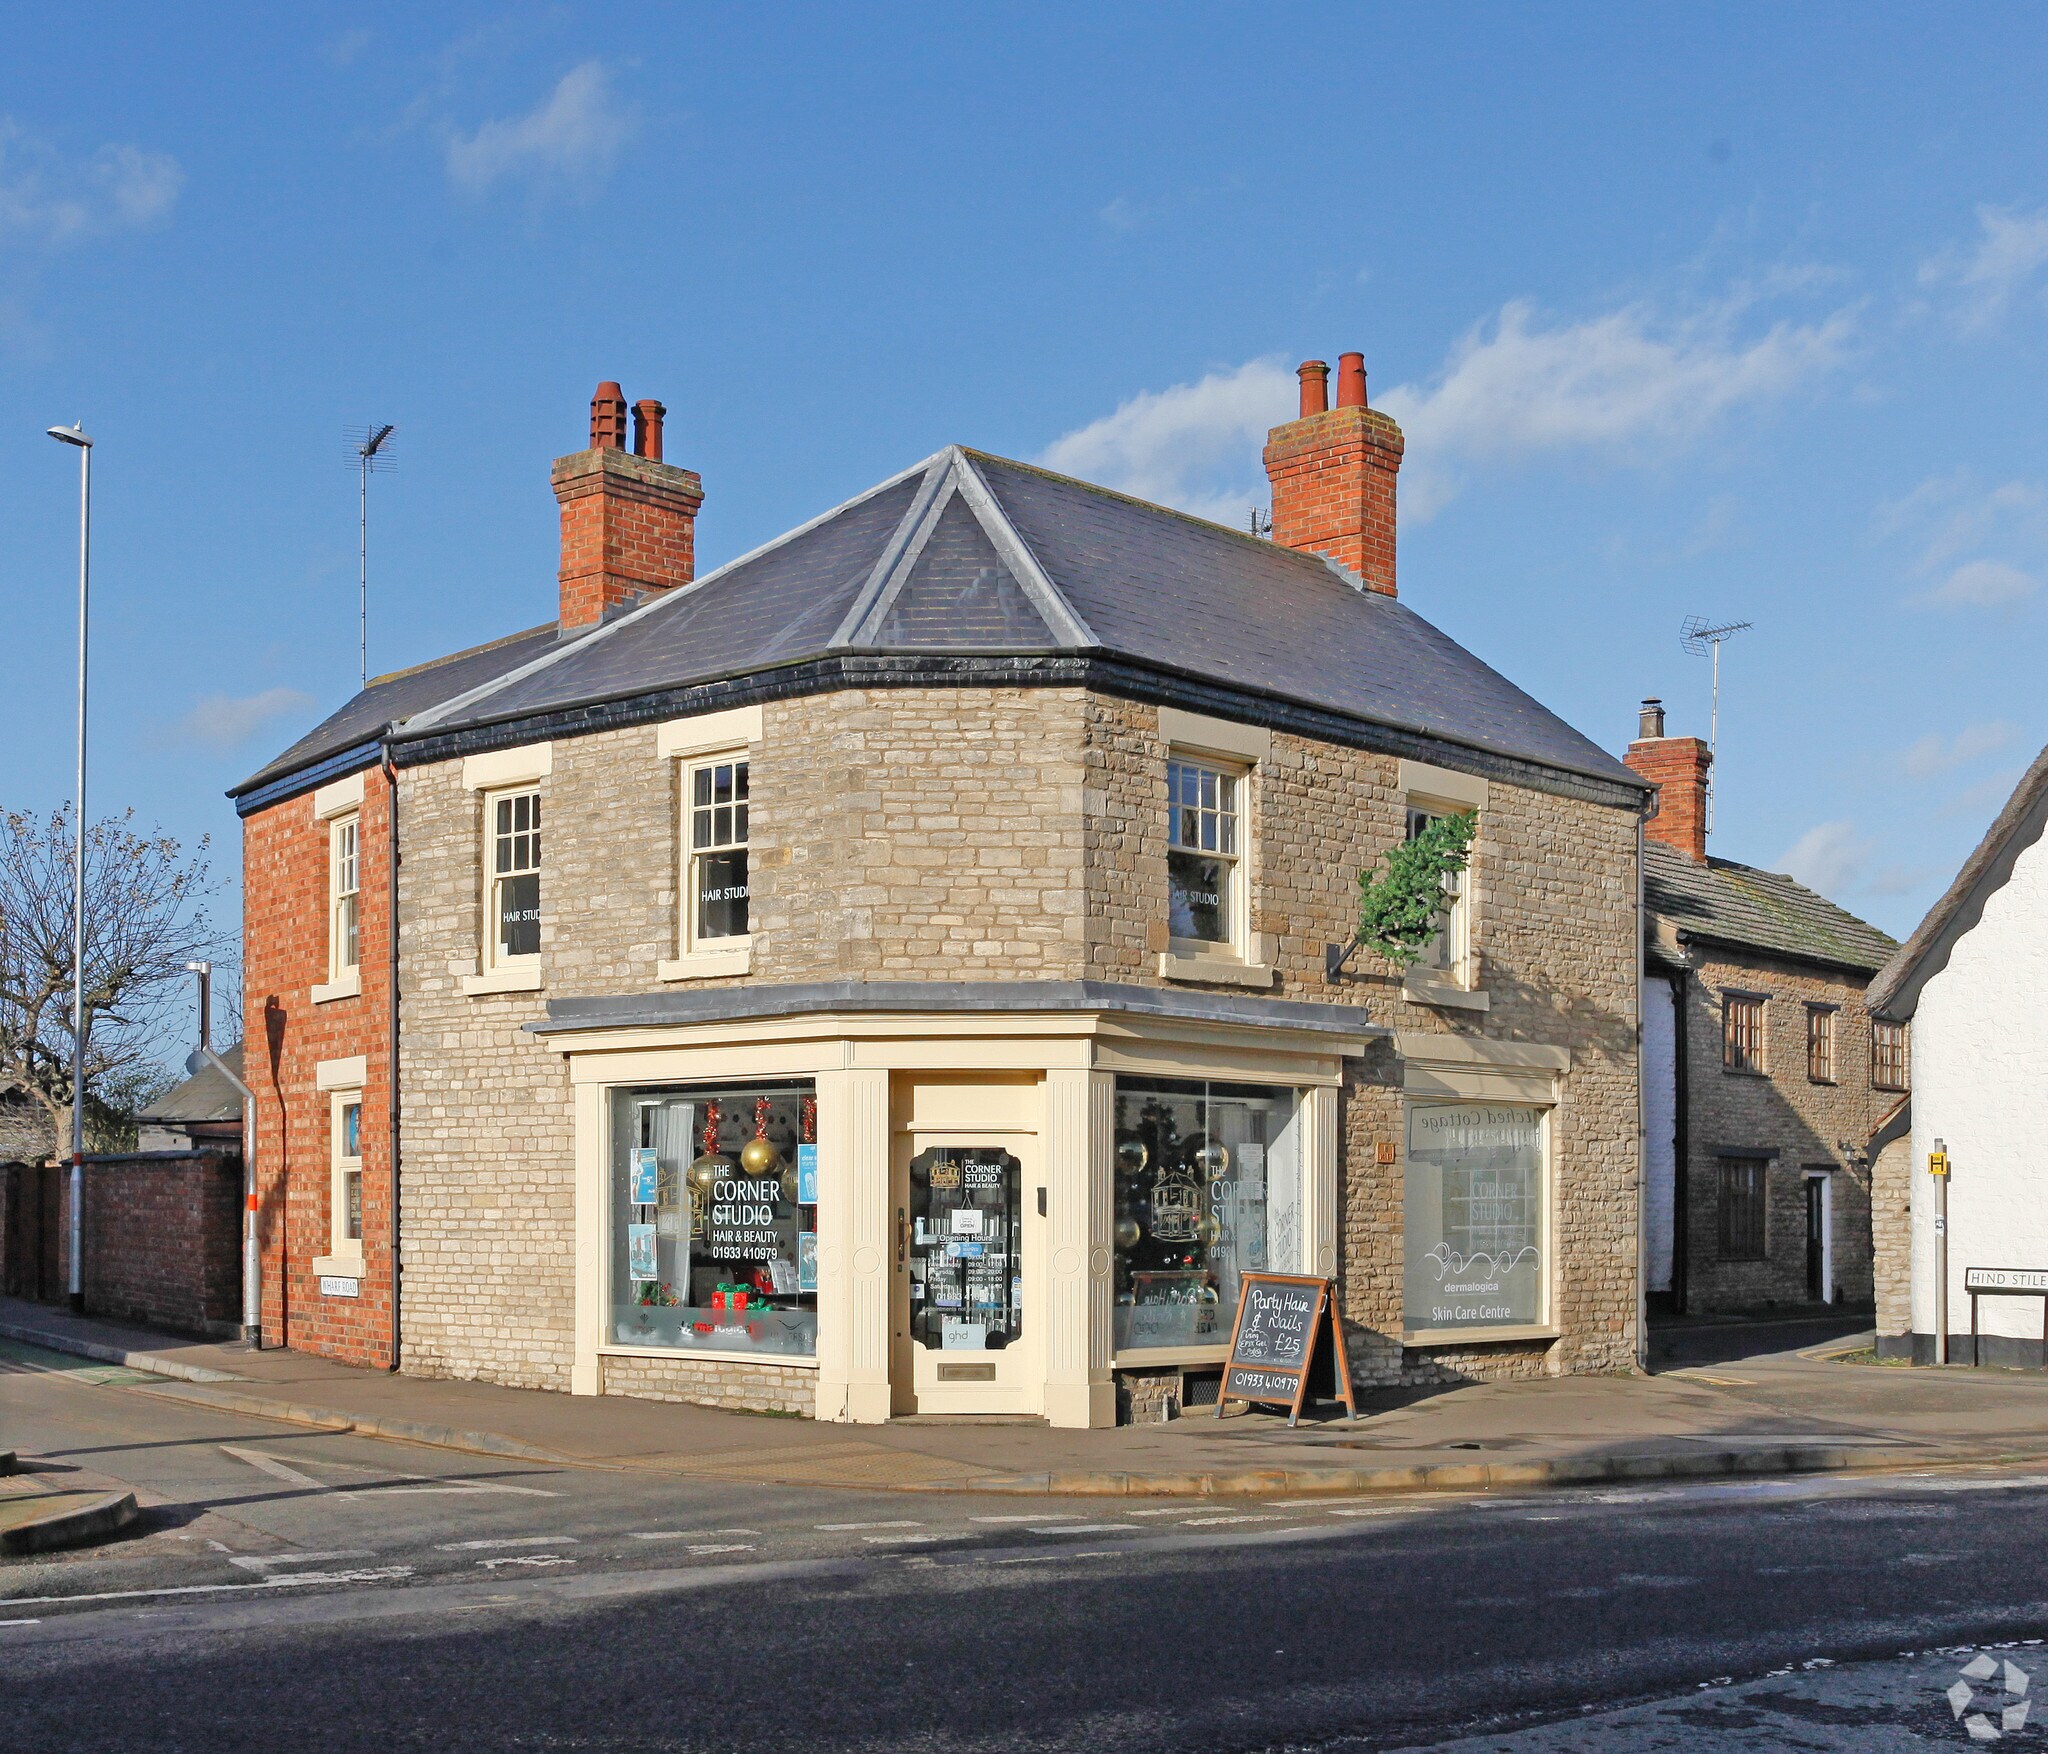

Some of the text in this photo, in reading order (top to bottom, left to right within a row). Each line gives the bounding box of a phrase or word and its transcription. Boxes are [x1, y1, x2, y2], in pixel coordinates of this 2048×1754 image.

[702, 889, 721, 902] HAIR
[1190, 891, 1219, 905] STUDIO
[503, 911, 520, 923] HAIR
[965, 1165, 1002, 1174] CORNER
[1930, 1155, 1944, 1172] H
[713, 1165, 730, 1177] THE
[965, 1173, 998, 1183] STUDIO
[713, 1180, 780, 1201] CORNER
[713, 1204, 772, 1226] STUDIO
[713, 1230, 778, 1243] HAIR & BEAUTY
[940, 1235, 969, 1243] Opening
[1210, 1230, 1230, 1241] HAIR
[712, 1246, 778, 1260] 01933 410979
[1971, 1272, 2047, 1287] HIND STILE
[342, 1281, 357, 1294] ROAD
[1444, 1281, 1499, 1293] dermalogica
[1252, 1290, 1310, 1318] Party Hair
[1432, 1305, 1511, 1321] Skin Care Centre
[948, 1330, 969, 1344] ghd
[1275, 1333, 1301, 1351] £25
[1235, 1373, 1299, 1393] 01933 410979
